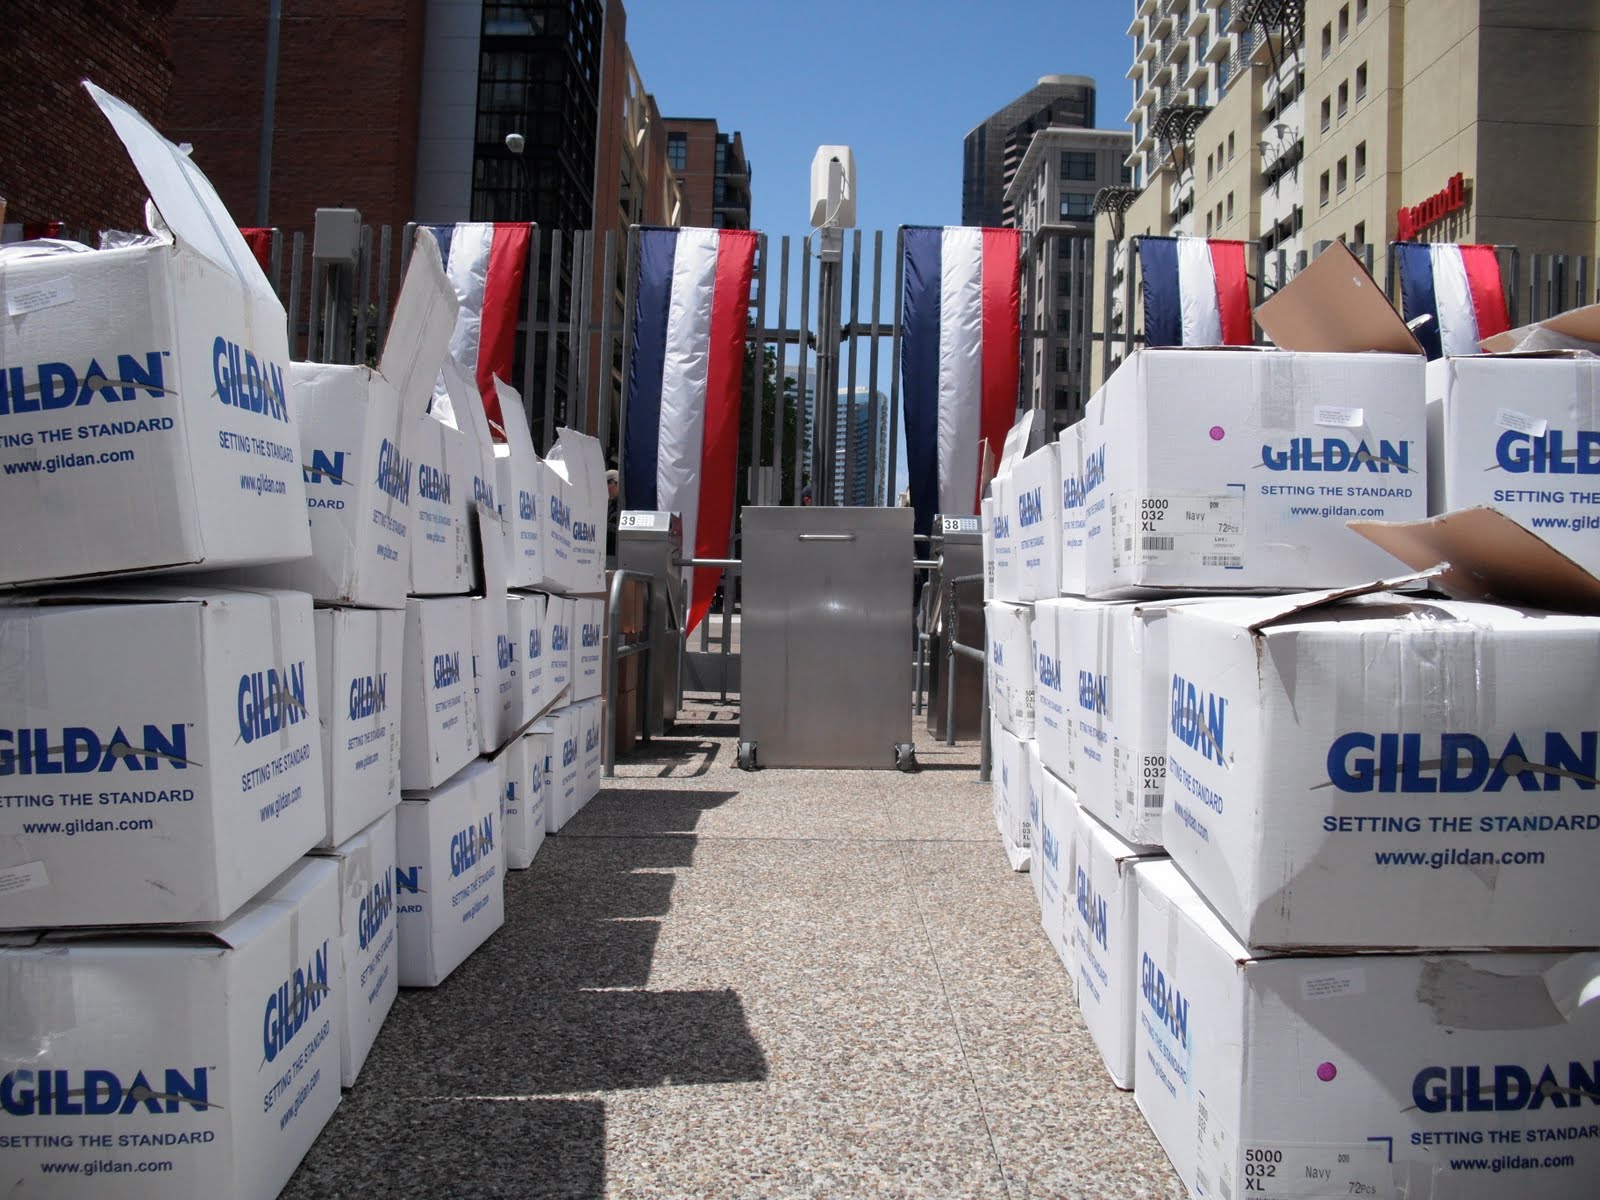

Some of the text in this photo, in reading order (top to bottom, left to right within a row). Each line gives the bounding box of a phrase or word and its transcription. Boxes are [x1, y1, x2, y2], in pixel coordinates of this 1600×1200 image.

[213, 336, 288, 423] GILDAN
[38, 428, 73, 443] THE
[78, 417, 174, 439] STANDARD
[219, 430, 294, 463] SETTING THE STANDARD
[1262, 438, 1409, 474] GILDAN
[4, 450, 135, 474] www.gildan.com
[378, 438, 412, 506] GILDAN
[240, 474, 286, 496] www.gildan.com
[419, 464, 450, 504] GILDAN
[1261, 486, 1413, 497] SETTING THE STANDARD
[1141, 499, 1168, 509] 5000
[1494, 489, 1600, 504] SETTING THE
[621, 515, 635, 525] 39
[1141, 510, 1164, 520] 032
[1185, 511, 1206, 521] Navy
[1291, 506, 1384, 517] www.gildan.com
[944, 519, 958, 529] 38
[1141, 521, 1157, 531] XL
[1218, 523, 1239, 533] 72Pcs
[434, 652, 460, 689] GILDAN
[238, 661, 306, 744] GILDAN
[350, 672, 386, 721] GILDAN
[1078, 670, 1107, 716] GILDAN
[1172, 673, 1225, 766] GILDAN
[242, 744, 311, 792] SETTING THE STANDARD
[1144, 756, 1167, 767] 500
[1327, 731, 1598, 793] GILDAN
[1144, 768, 1166, 778] 032
[1144, 779, 1159, 789] XL
[1182, 767, 1192, 792] THE
[1192, 778, 1224, 814] STANDARD
[59, 793, 93, 806] THE
[98, 789, 194, 805] STANDARD
[23, 818, 153, 835] www.gildan.com
[1323, 815, 1600, 832] SETTING THE STANDARD
[451, 812, 493, 877] GILDAN
[1375, 848, 1545, 869] www.gildan.com
[359, 865, 392, 950] GILDAN
[1077, 864, 1107, 952] GILDAN
[264, 940, 328, 1062] GILDAN
[1142, 952, 1188, 1050] GILDAN
[0, 1067, 208, 1116] GILDAN
[264, 1074, 292, 1113] SETTING
[292, 1056, 304, 1077] THE
[1412, 1060, 1600, 1114] GILDAN
[0, 1130, 215, 1148] SETTING THE STANDARD
[1411, 1124, 1600, 1145] SETTING THE STANDAR
[1245, 1149, 1283, 1163] 5000
[1450, 1154, 1574, 1172] www.gildan.com
[41, 1160, 173, 1176] www.gildan.com
[1245, 1164, 1276, 1177] 032
[1305, 1165, 1331, 1181] Navy
[1245, 1178, 1265, 1191] XL
[1348, 1181, 1377, 1195] 72Pcs
